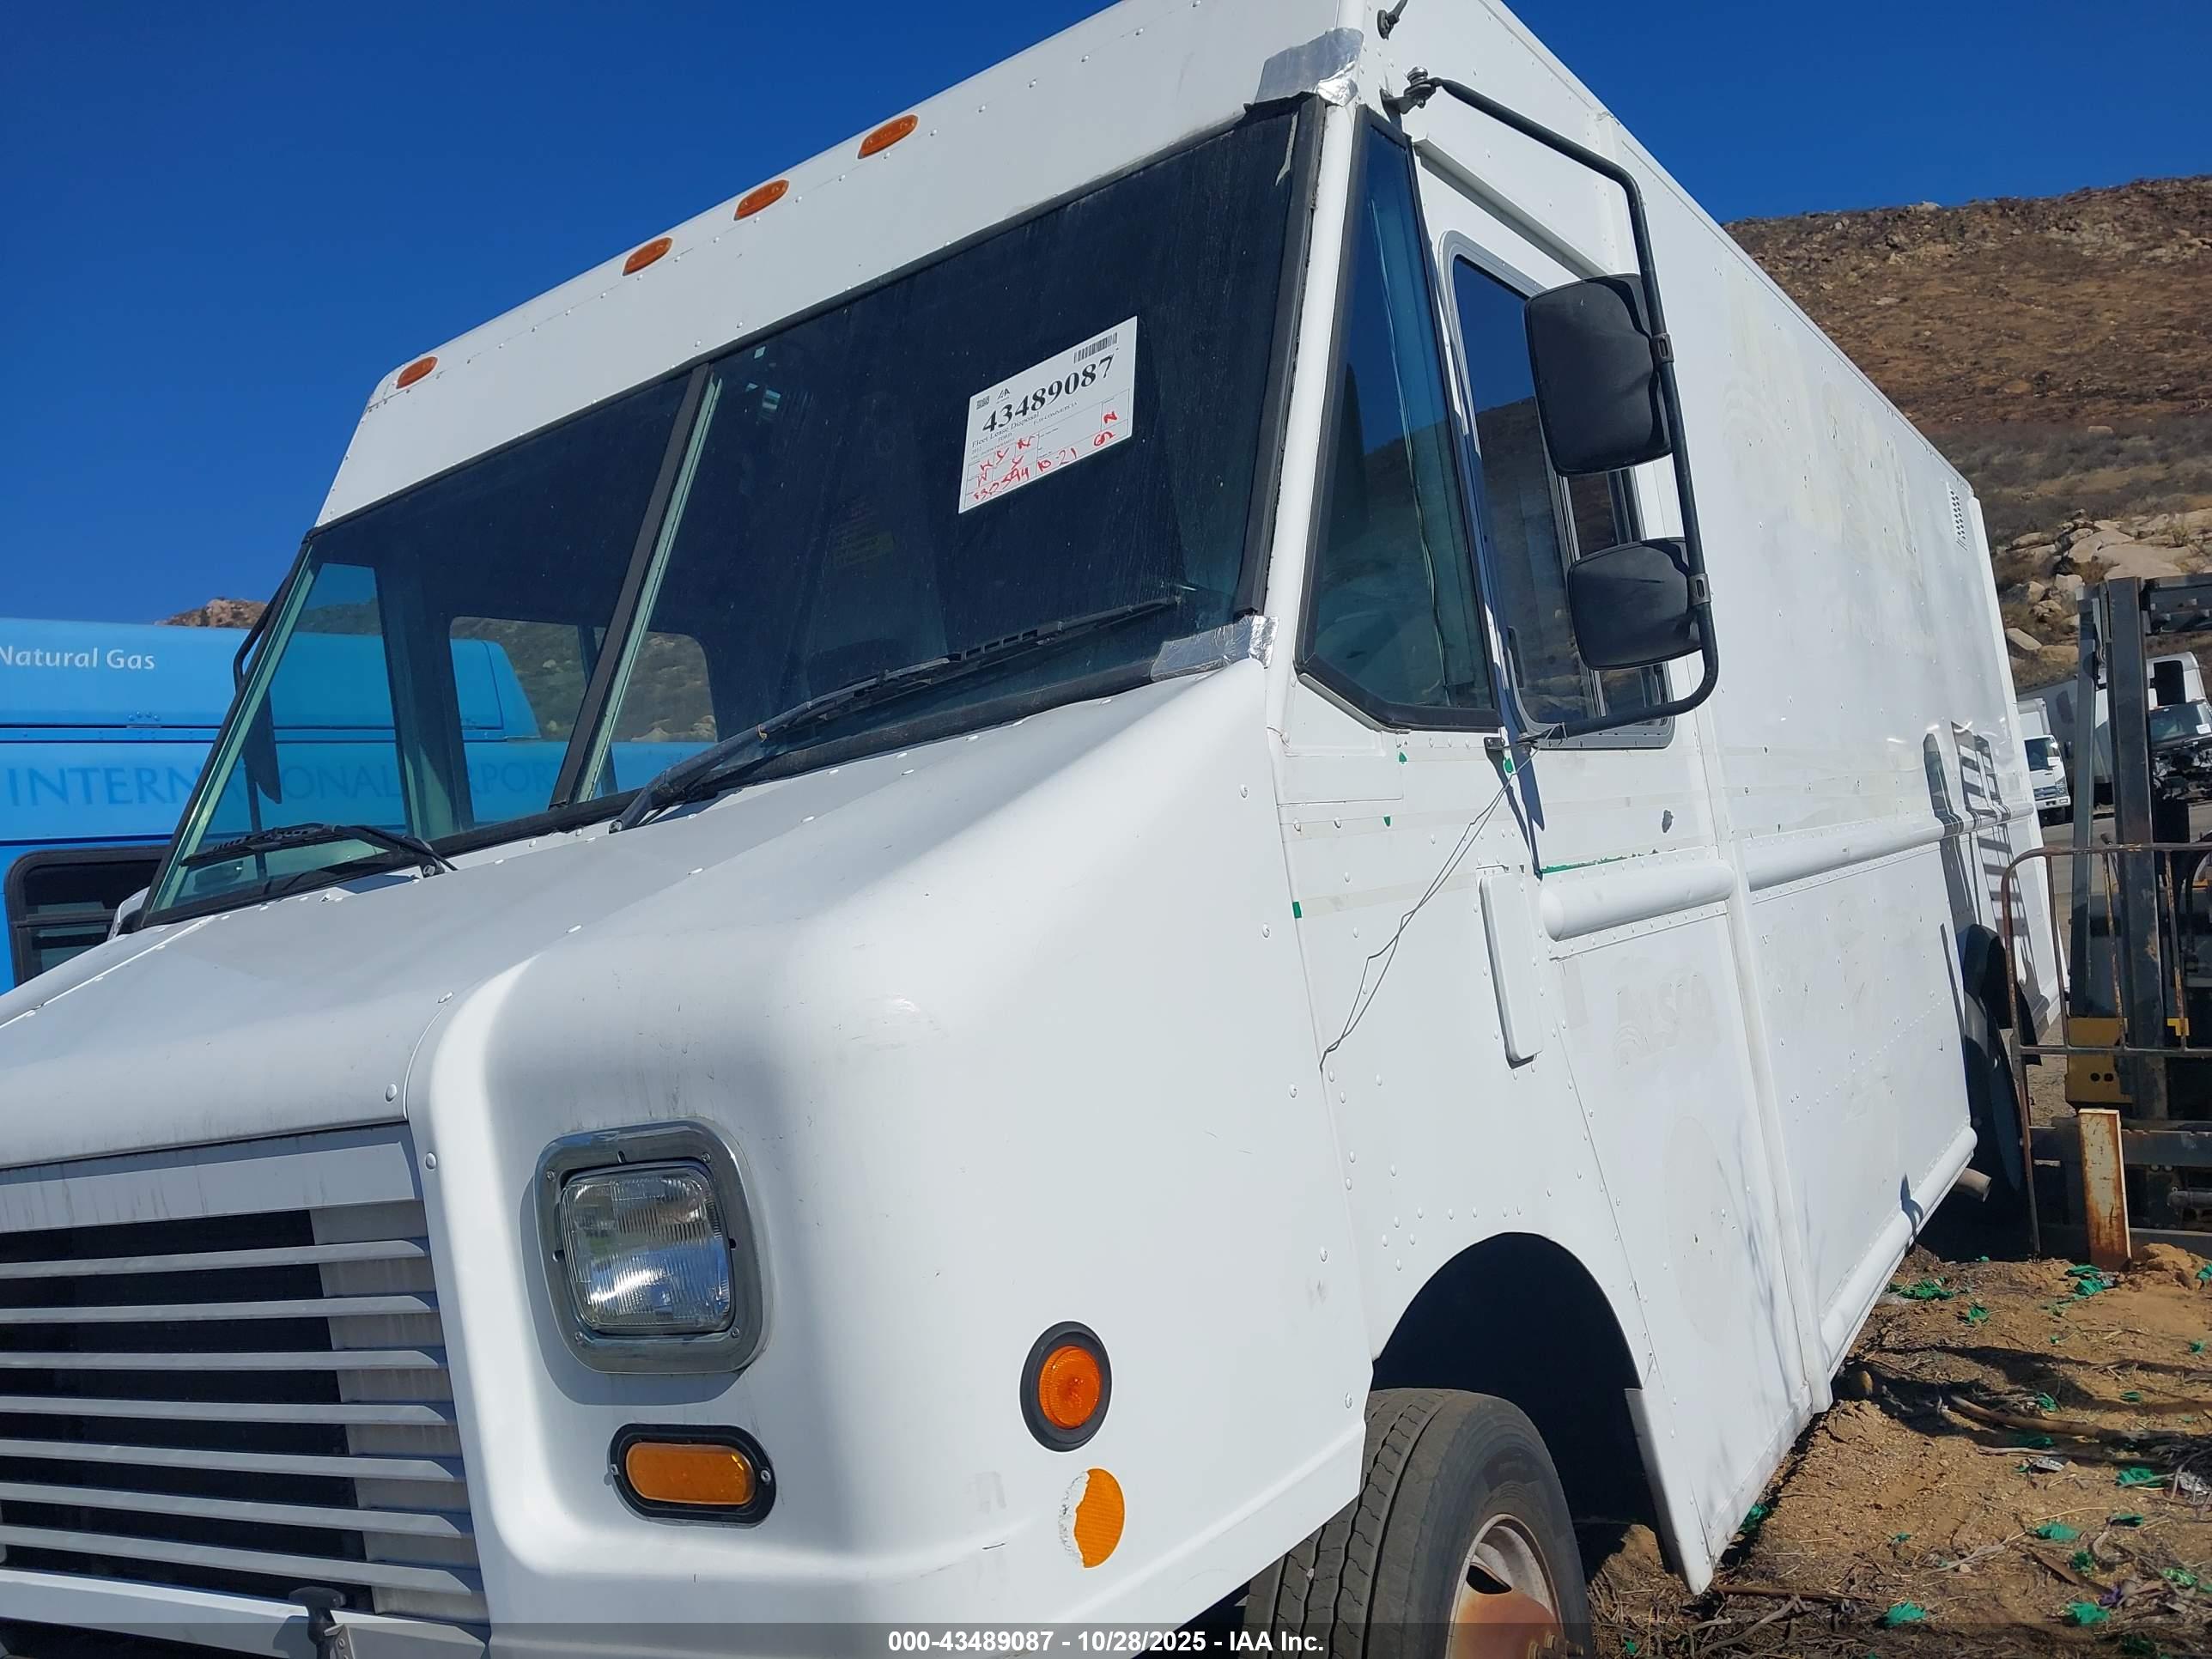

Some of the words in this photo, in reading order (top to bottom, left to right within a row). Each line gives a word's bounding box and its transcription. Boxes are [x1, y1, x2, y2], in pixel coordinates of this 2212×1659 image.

[982, 353, 1115, 433] 43489087
[1011, 410, 1040, 431] Disposal
[0, 645, 99, 669] Natural
[106, 648, 155, 670] Gas
